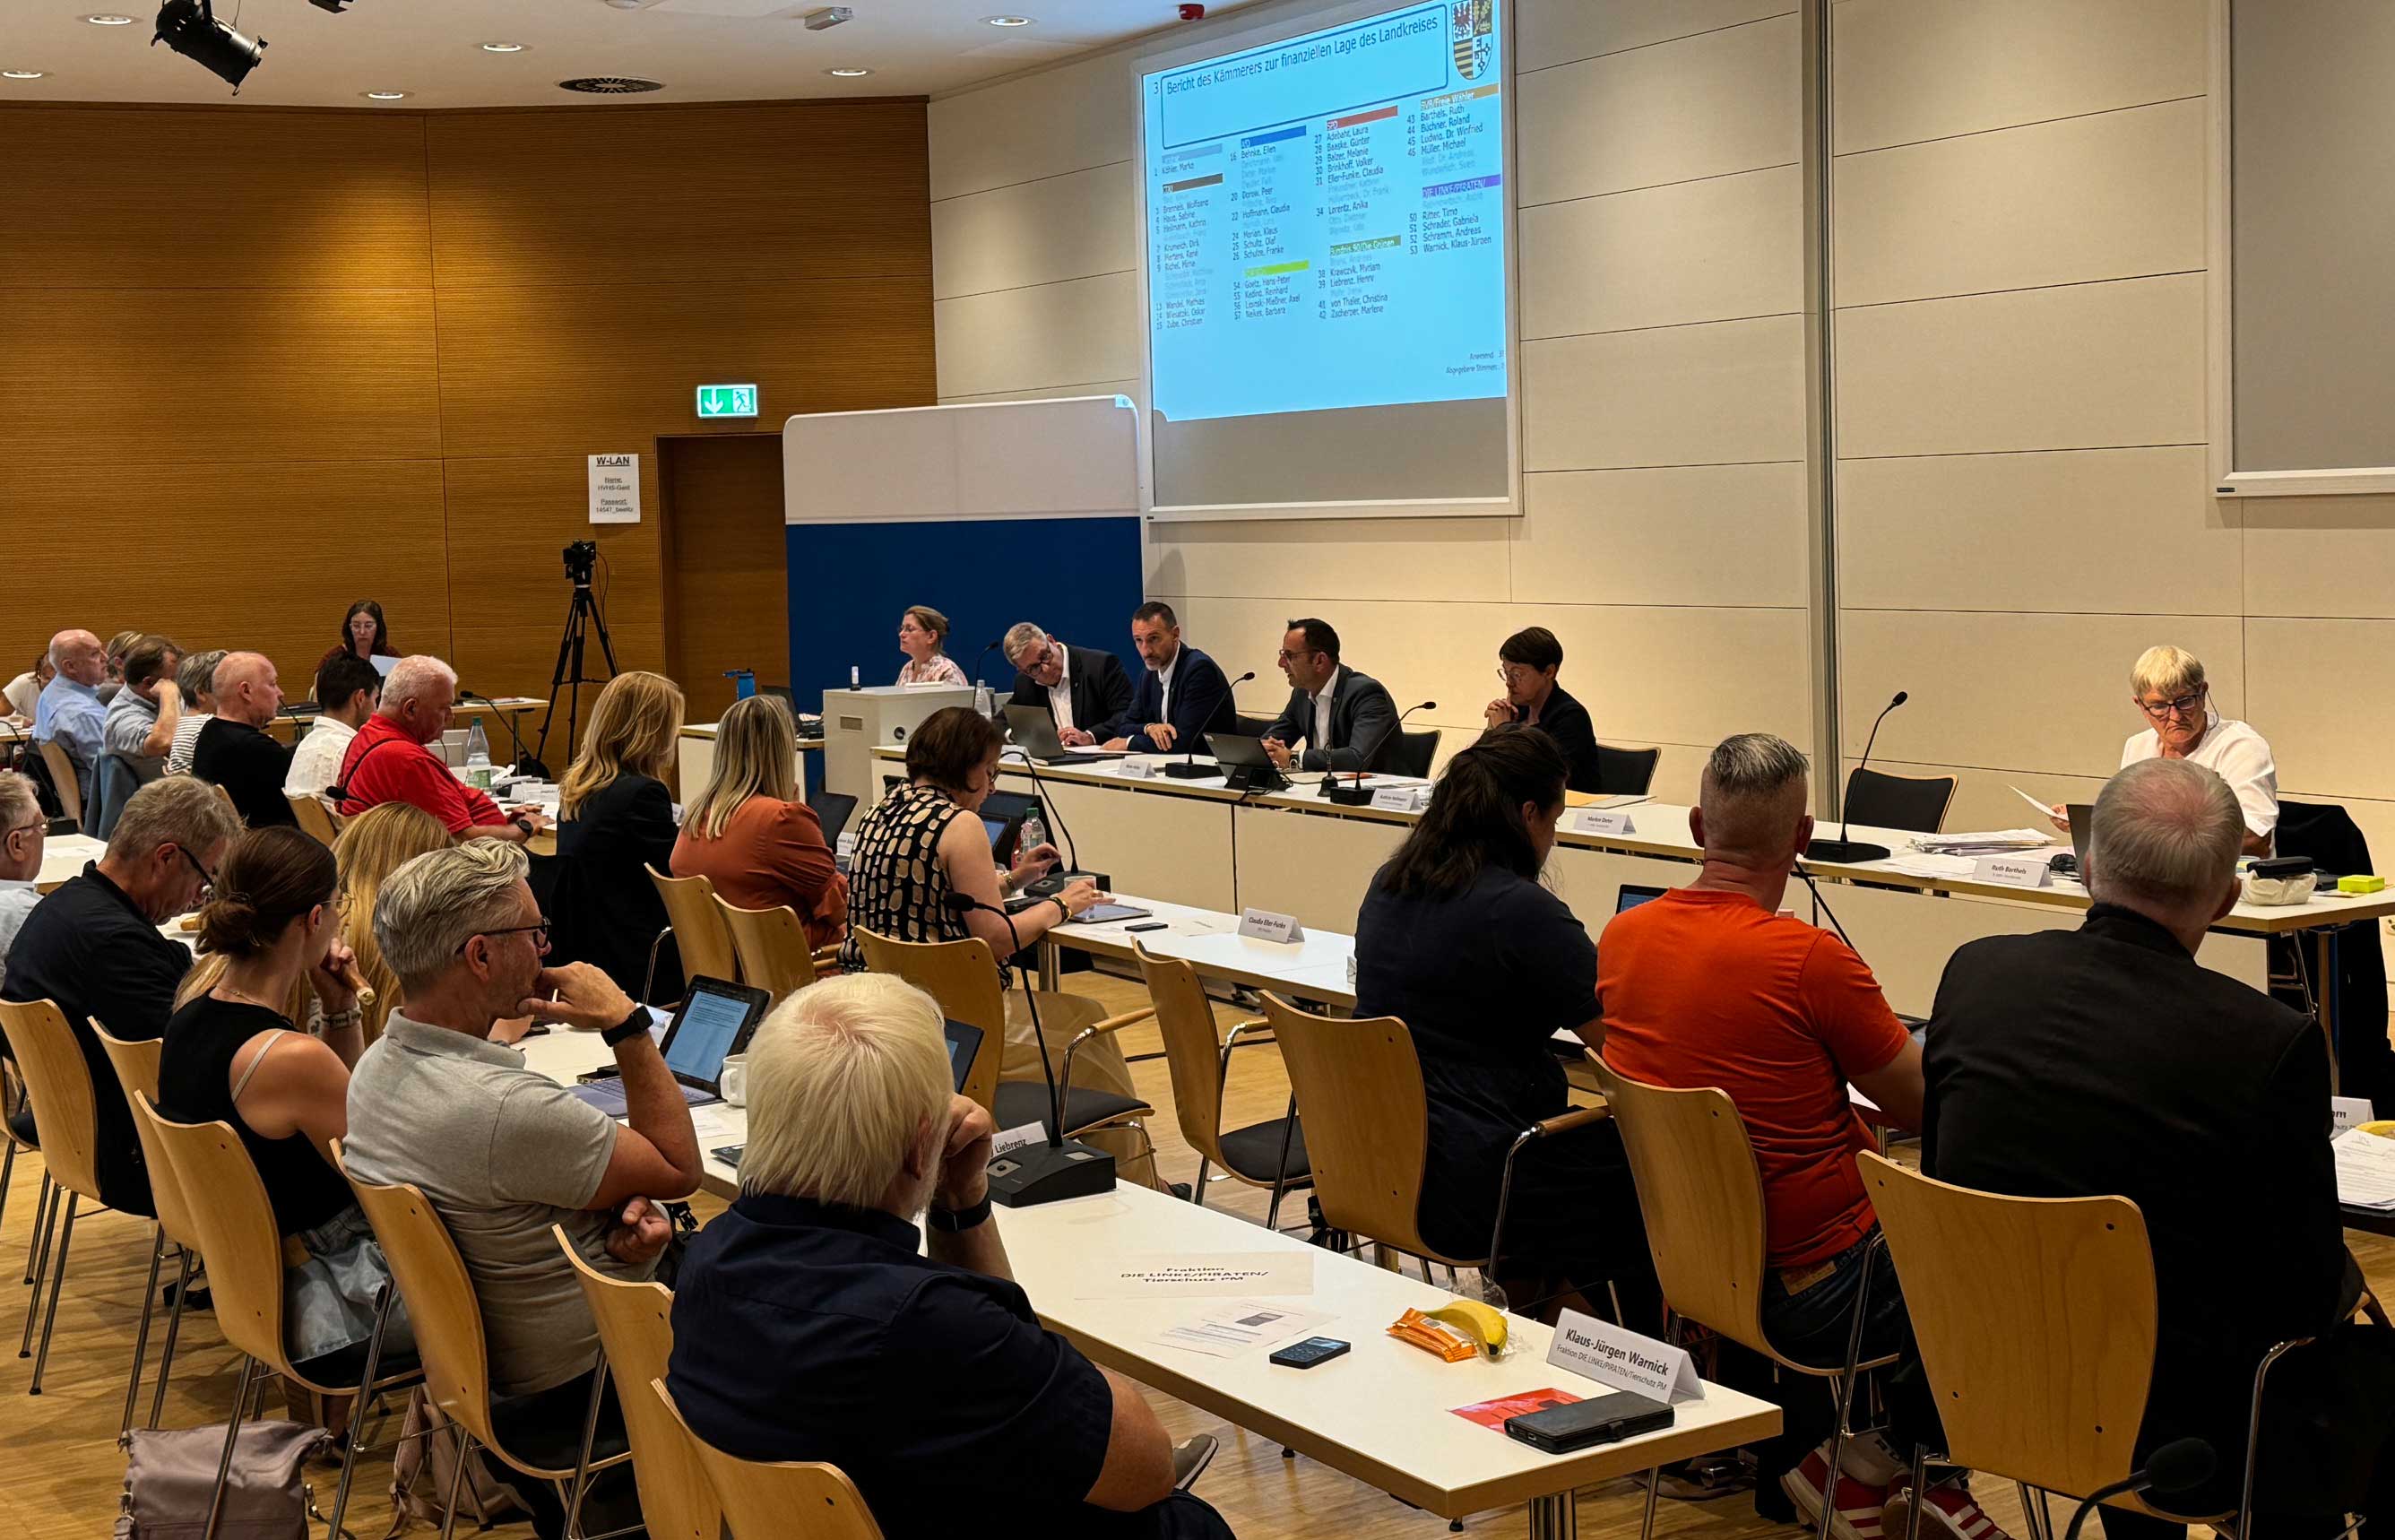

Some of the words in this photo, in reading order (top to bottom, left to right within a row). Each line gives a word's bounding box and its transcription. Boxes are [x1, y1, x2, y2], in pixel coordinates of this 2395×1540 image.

[1154, 82, 1160, 94] 3
[1167, 77, 1195, 95] Bericht
[1197, 74, 1212, 88] des
[1214, 61, 1263, 84] Kämmerers
[1265, 57, 1280, 72] zur
[1281, 41, 1332, 69] finanziellen
[1335, 36, 1357, 56] Lage
[1360, 30, 1377, 48] des
[1379, 16, 1438, 43] Landkreises
[1406, 114, 1415, 124] 43
[1448, 104, 1465, 116] Ruth
[1352, 126, 1369, 136] Laura
[1406, 125, 1415, 135] 44
[1448, 114, 1470, 127] Roland
[1456, 122, 1483, 137] Winfried
[1442, 137, 1466, 151] Michael
[1409, 212, 1417, 223] 50
[1441, 207, 1458, 217] Timo
[1455, 226, 1482, 238] Andreas
[596, 455, 630, 467] W-LAN
[1991, 864, 2004, 873] Ruth
[2005, 865, 2027, 876] Barthels
[1248, 916, 1264, 926] Claudia
[995, 1138, 1028, 1154] Liebrenz
[1565, 1328, 1627, 1361] Klaus-Jürgen
[1630, 1351, 1669, 1377] Warnick
[1557, 1344, 1578, 1359] Fraktion
[1578, 1351, 1588, 1362] DIE
[1587, 1354, 1656, 1388] LINKE/PIRATEN/Tierschutz
[1656, 1380, 1667, 1390] PM
